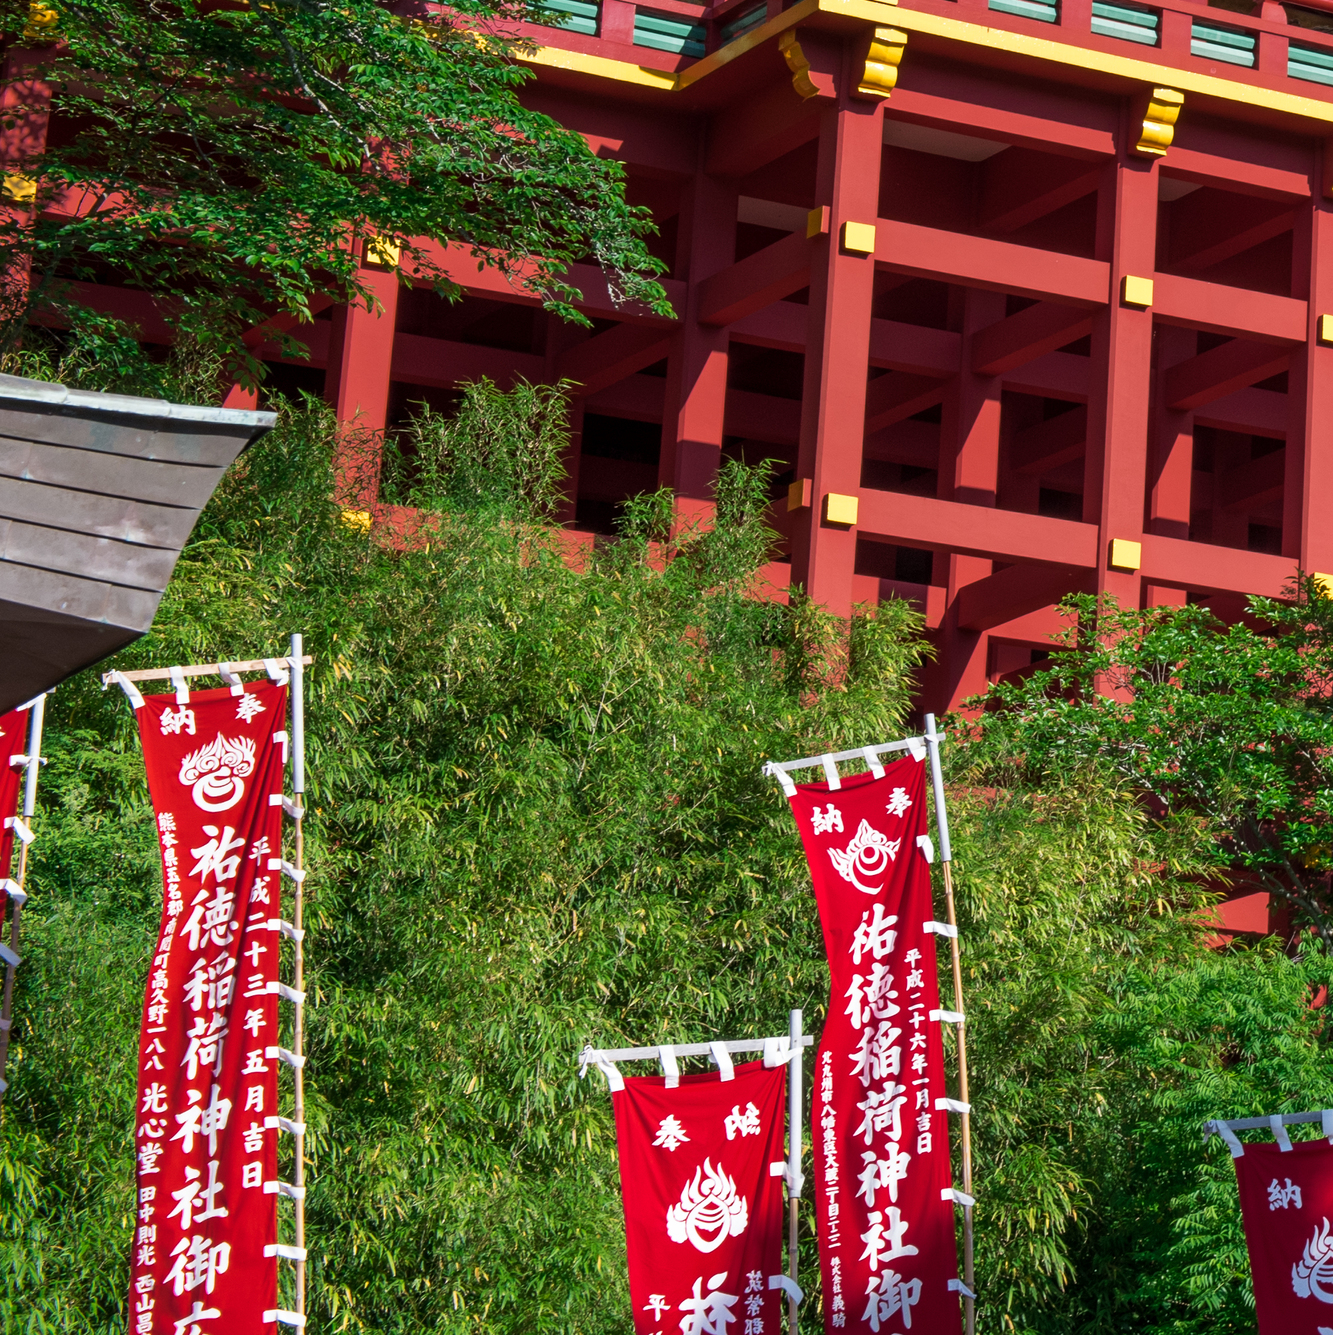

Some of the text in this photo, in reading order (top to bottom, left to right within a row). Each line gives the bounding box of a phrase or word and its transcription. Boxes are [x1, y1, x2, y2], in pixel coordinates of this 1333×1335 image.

[241, 835, 271, 1190] 平成二十三年五月吉日
[904, 947, 932, 1155] 平成二十六年一月吉日
[138, 1082, 168, 1176] 光心堂
[137, 1186, 157, 1267] 田中則光
[134, 1274, 156, 1335] 西山昌
